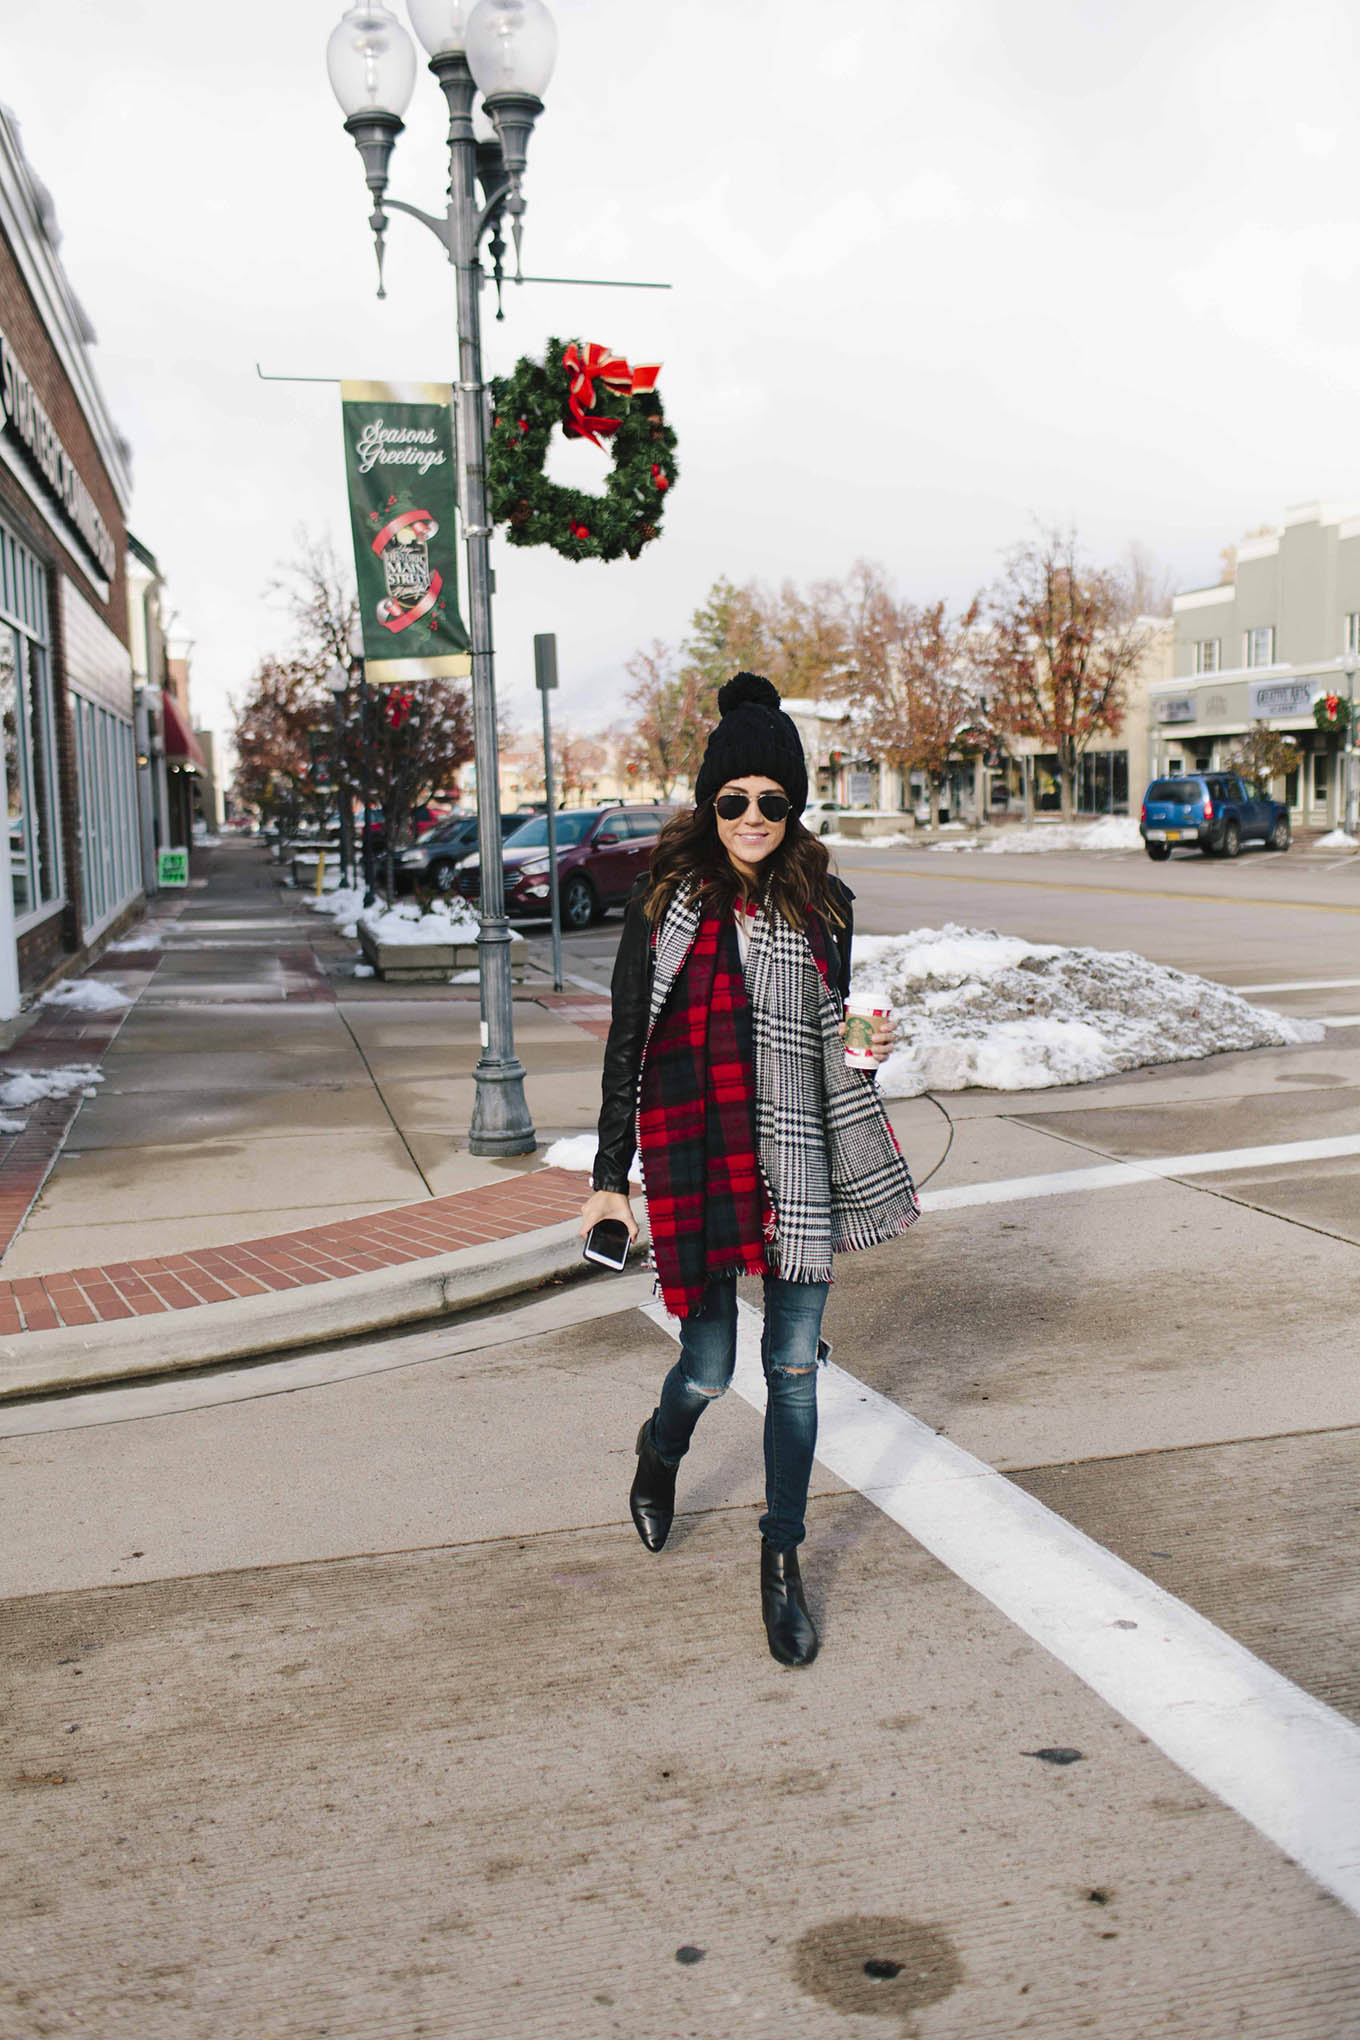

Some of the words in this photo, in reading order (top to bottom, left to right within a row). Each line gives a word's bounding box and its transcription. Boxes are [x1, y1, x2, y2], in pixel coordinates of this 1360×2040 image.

[362, 419, 438, 444] Seasons
[355, 440, 447, 475] Greetings
[387, 561, 427, 575] MAIN
[388, 574, 429, 586] STREET
